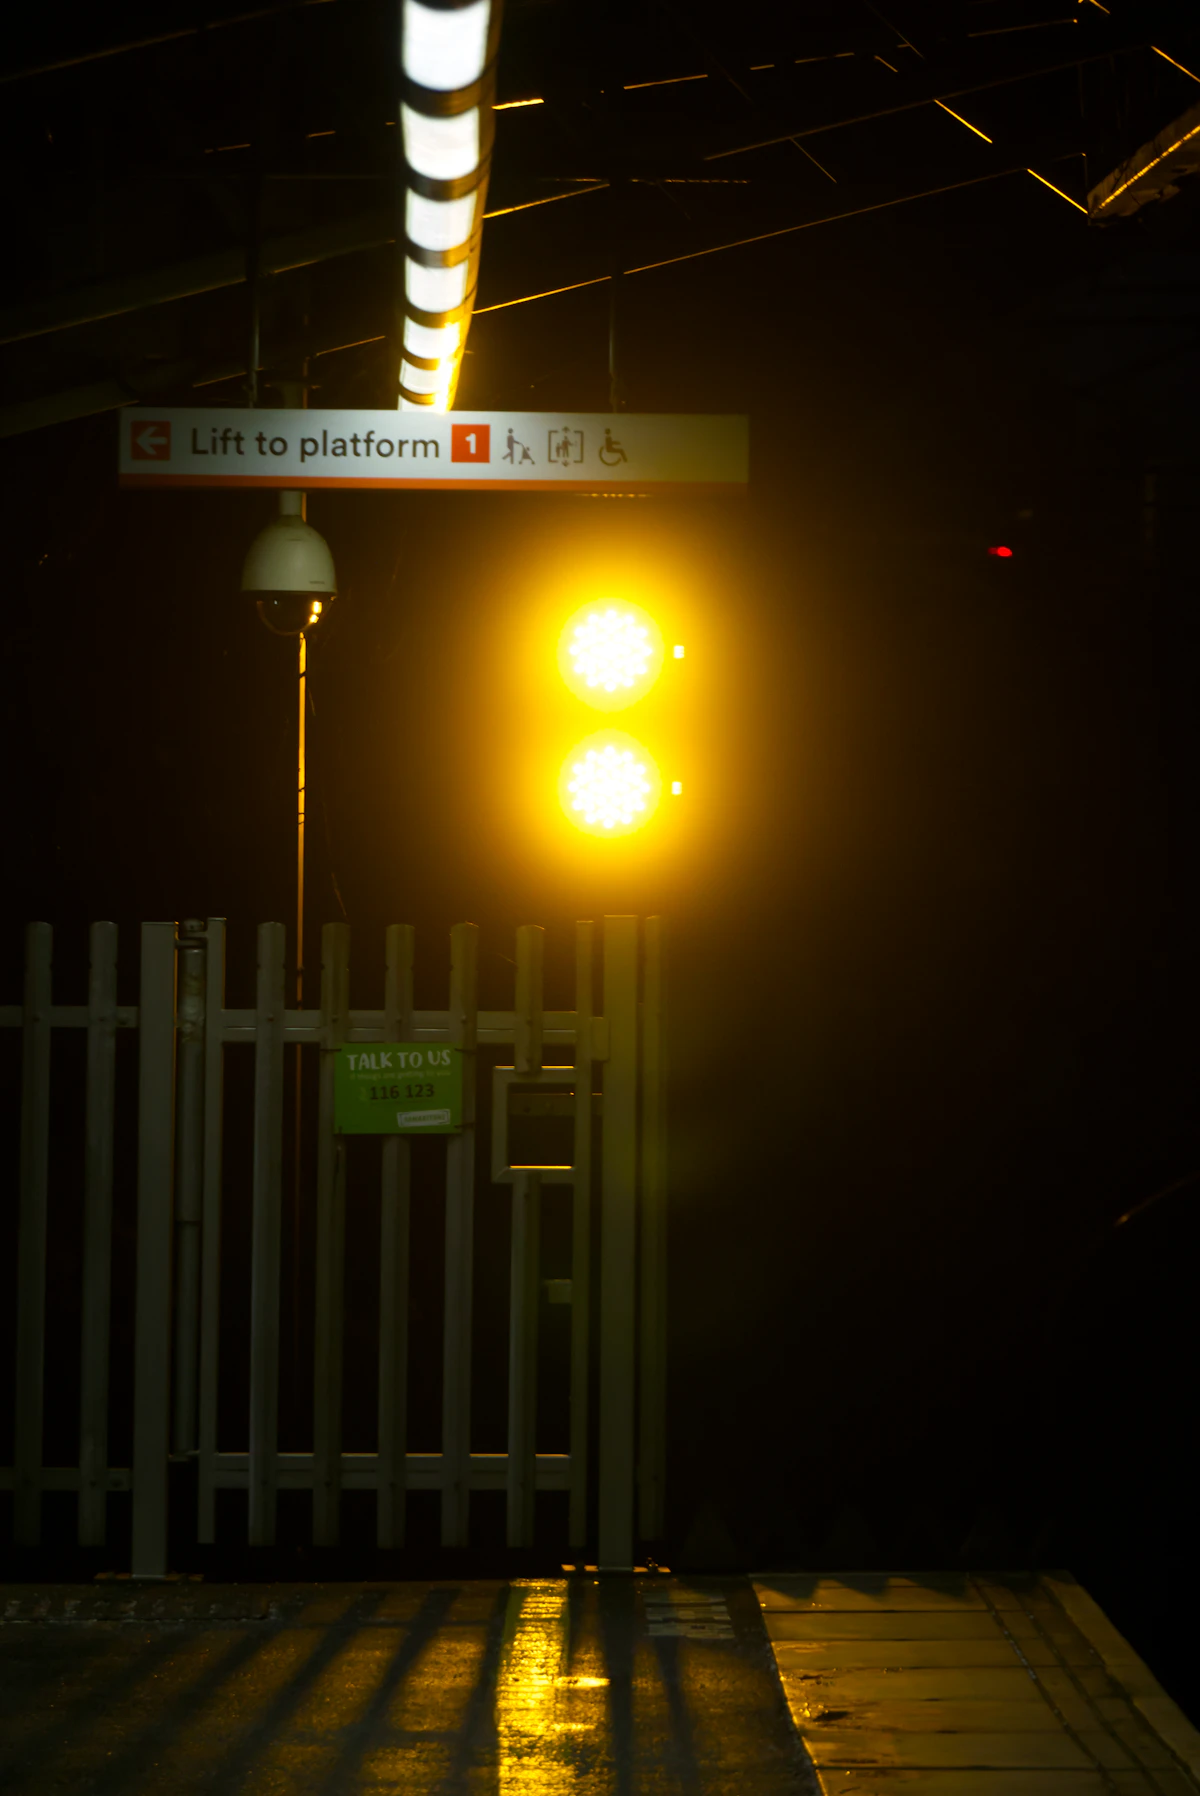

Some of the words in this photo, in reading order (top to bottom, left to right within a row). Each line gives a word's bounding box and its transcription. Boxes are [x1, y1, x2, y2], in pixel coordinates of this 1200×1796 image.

[191, 427, 245, 456] Lift
[255, 430, 288, 457] to
[300, 429, 440, 463] platform
[463, 431, 478, 456] 1
[346, 1051, 393, 1071] TALK
[396, 1051, 423, 1069] TO
[427, 1049, 452, 1067] US
[370, 1085, 400, 1100] 116
[405, 1083, 434, 1098] 123
